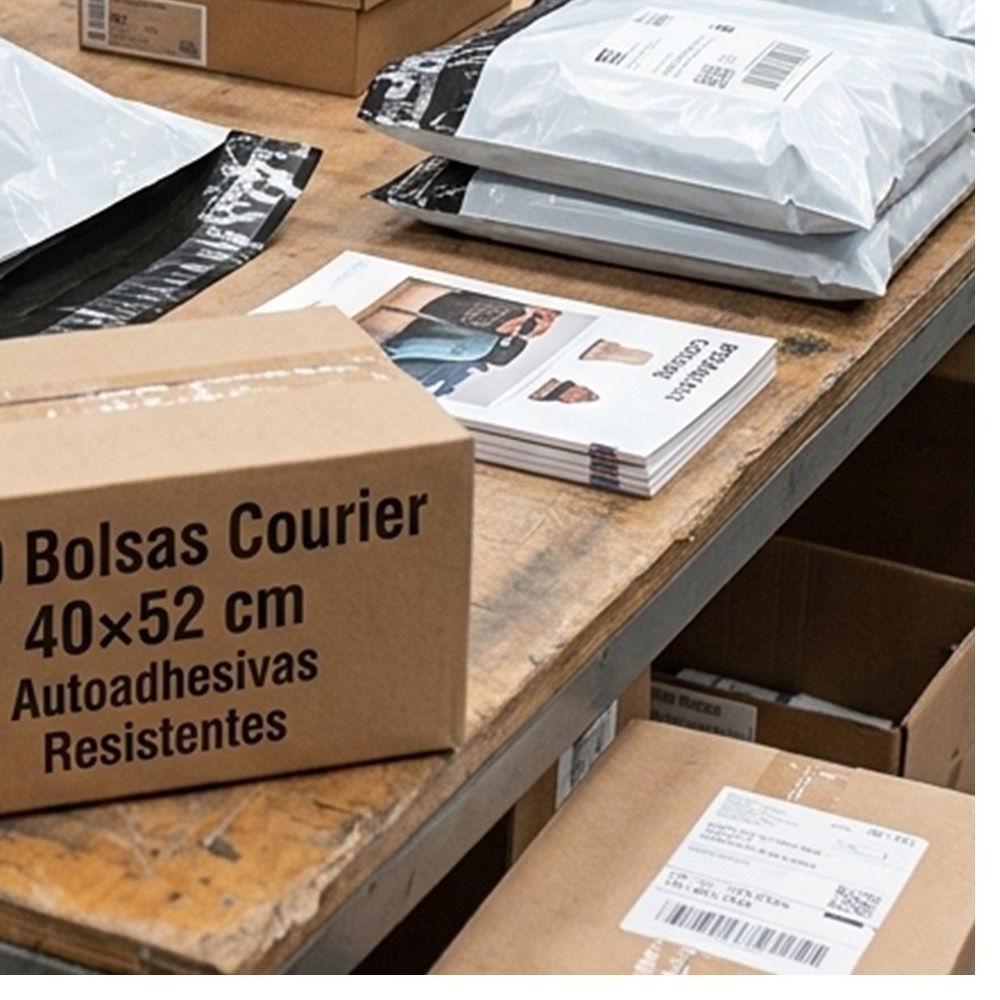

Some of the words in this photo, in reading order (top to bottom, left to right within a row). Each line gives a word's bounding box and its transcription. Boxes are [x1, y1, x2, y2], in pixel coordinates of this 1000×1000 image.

[25, 521, 209, 587] Bolsas
[228, 487, 429, 560] Courier
[224, 583, 304, 635] cm
[10, 648, 319, 722] Autoadhesivas
[44, 707, 288, 775] Resistentes
